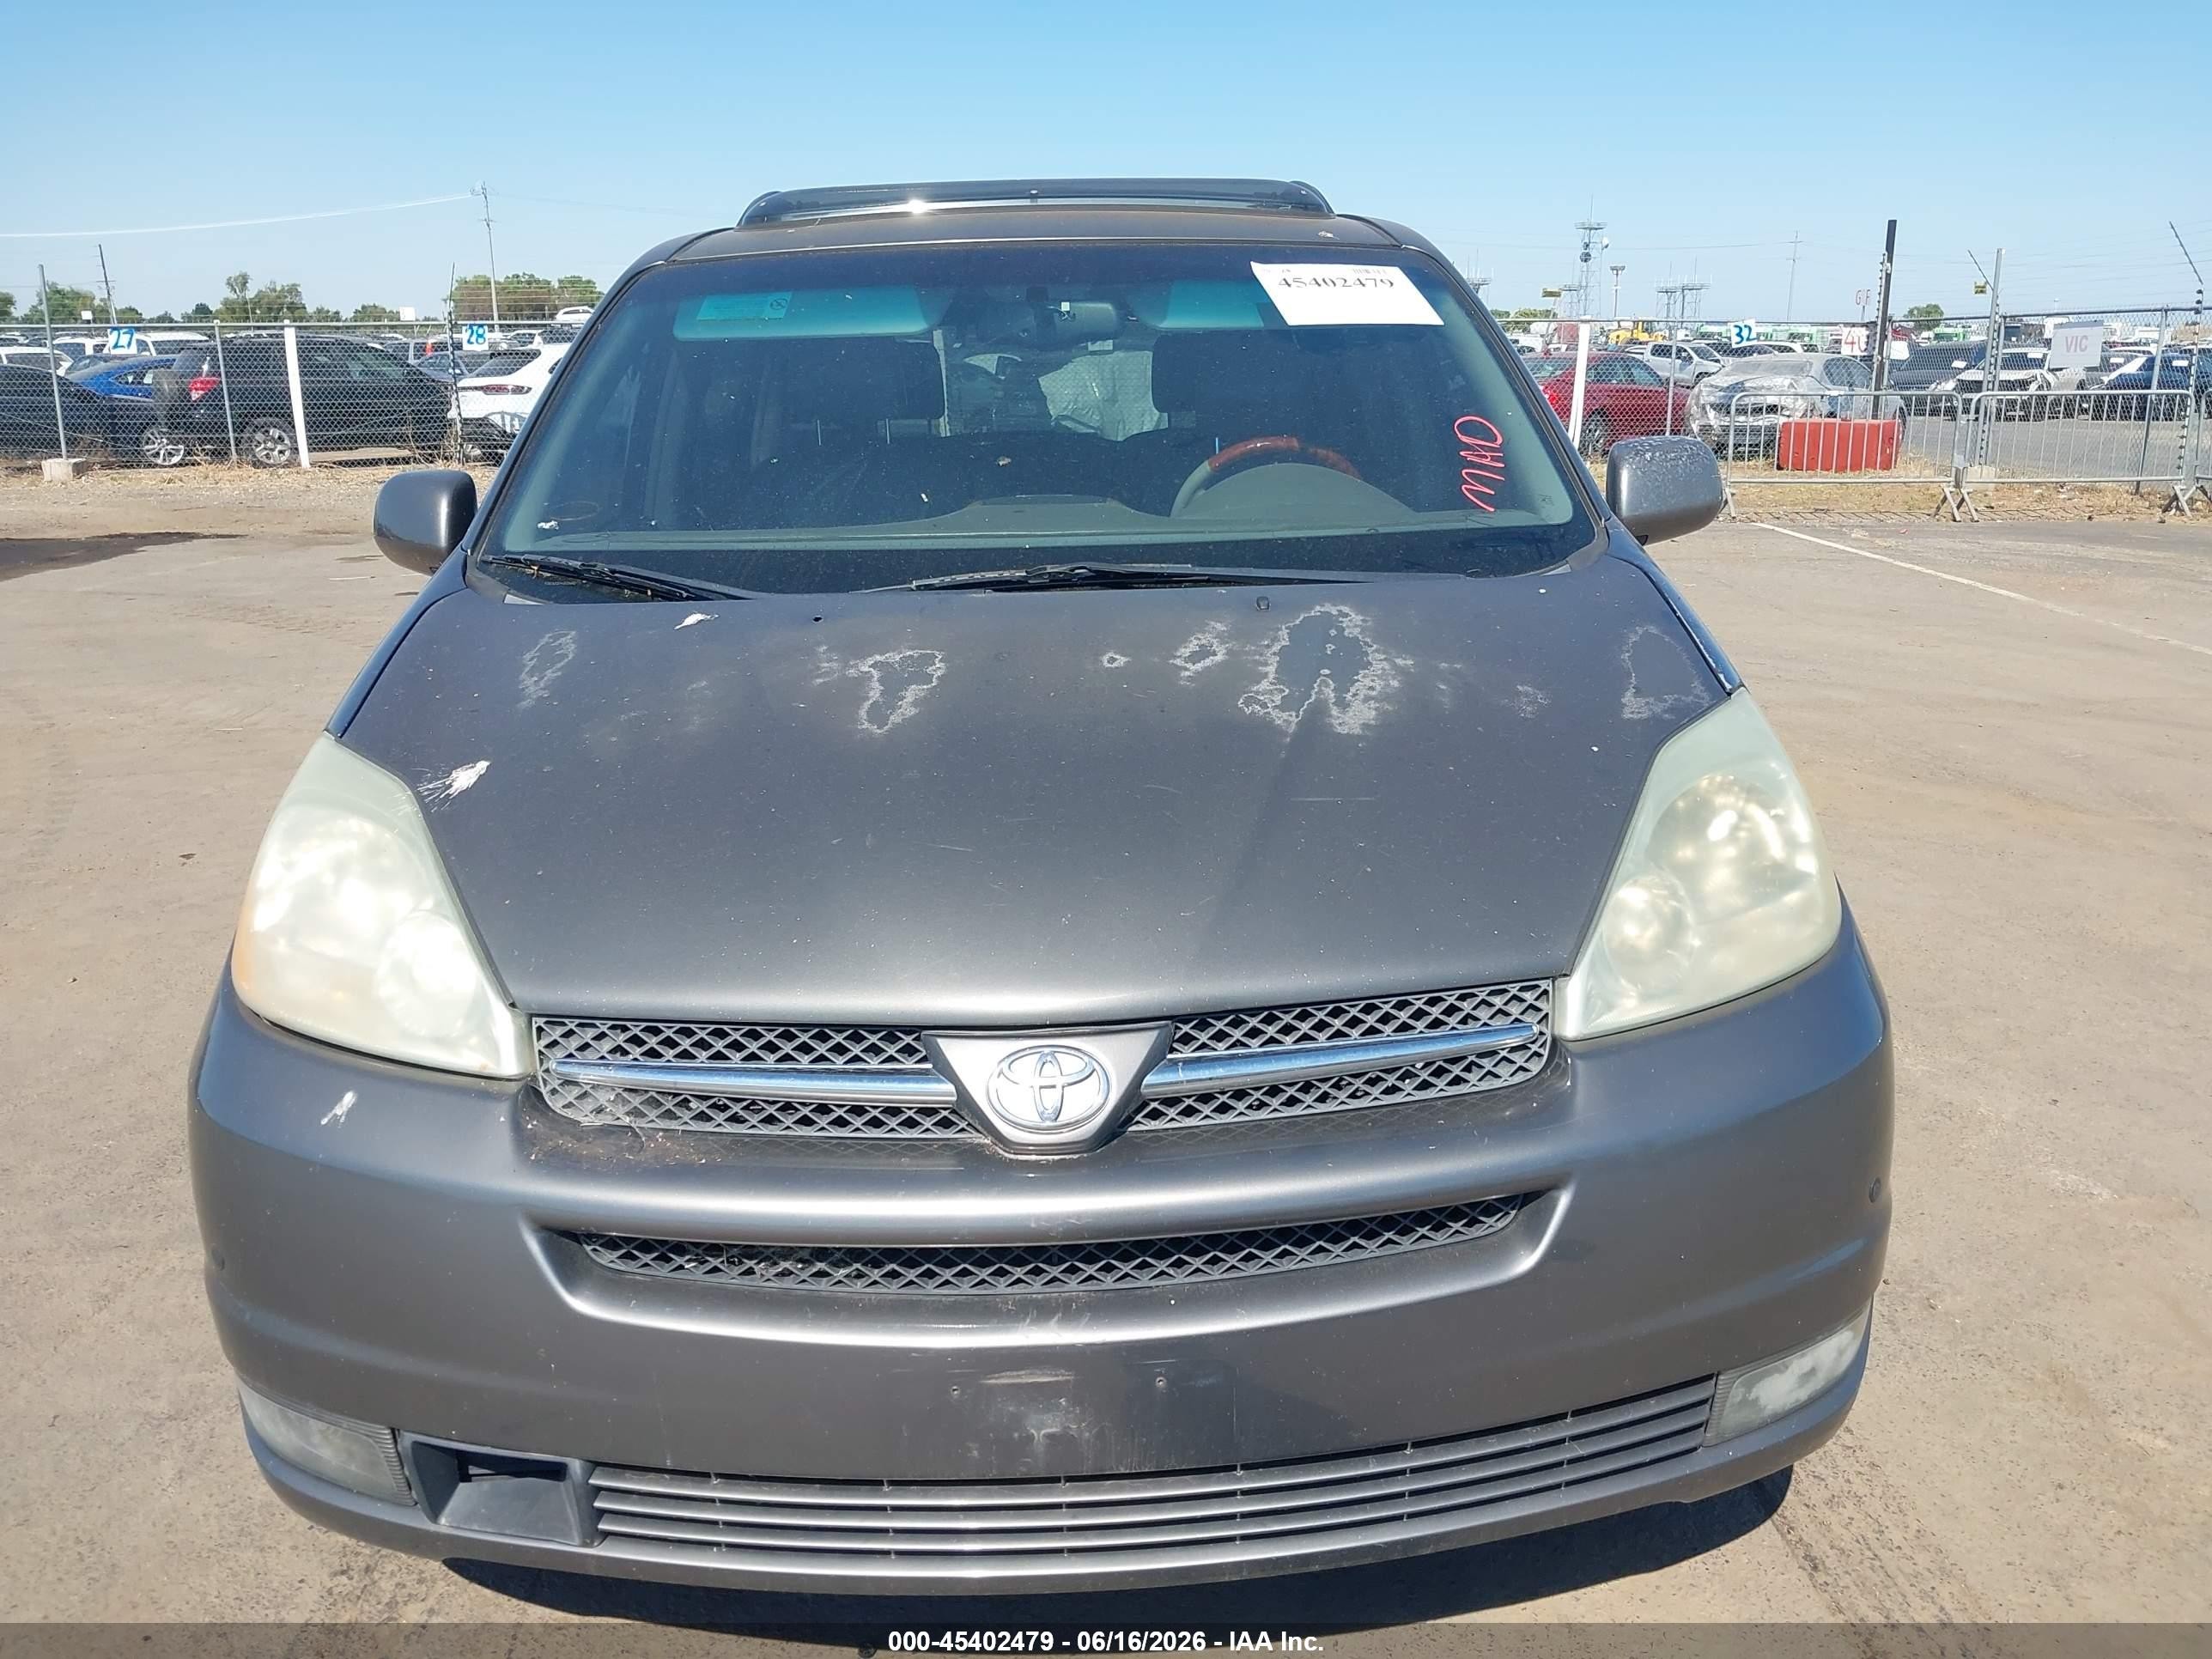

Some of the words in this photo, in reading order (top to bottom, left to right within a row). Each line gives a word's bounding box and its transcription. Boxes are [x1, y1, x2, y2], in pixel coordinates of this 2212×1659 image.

[1277, 276, 1395, 289] 45402479
[109, 326, 134, 349] 27
[465, 322, 487, 344] 28
[1733, 324, 1759, 344] 32
[2064, 334, 2089, 353] VIC
